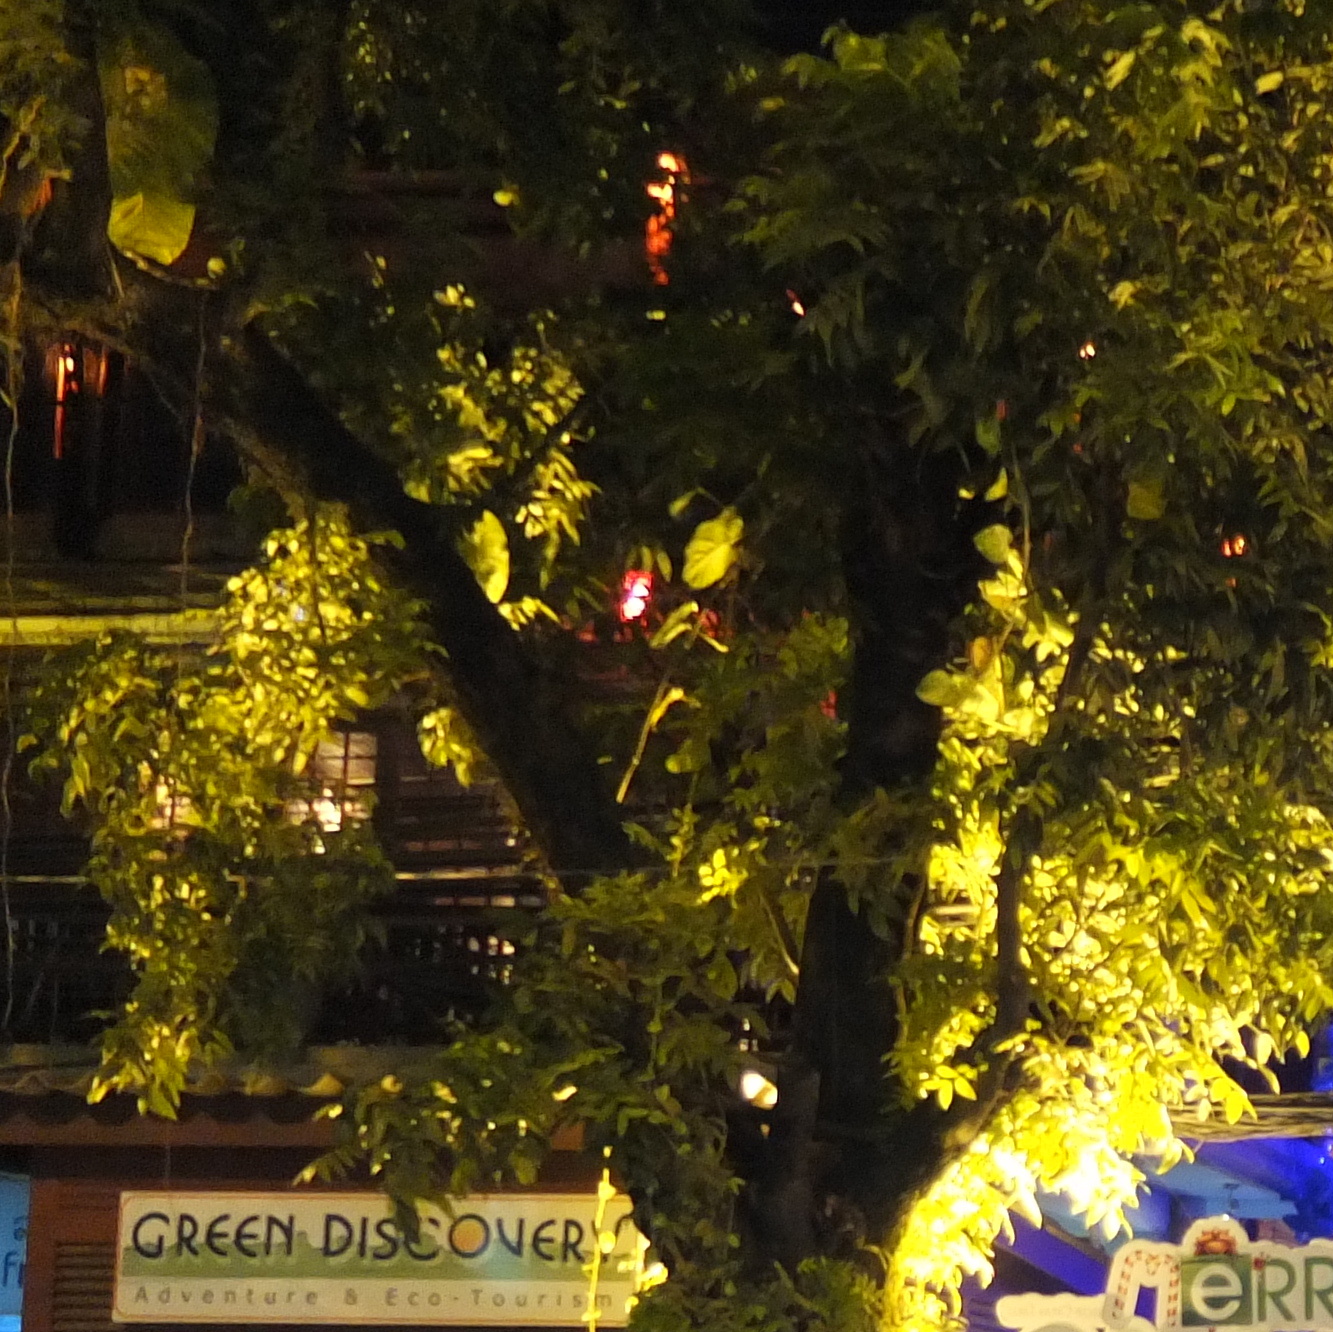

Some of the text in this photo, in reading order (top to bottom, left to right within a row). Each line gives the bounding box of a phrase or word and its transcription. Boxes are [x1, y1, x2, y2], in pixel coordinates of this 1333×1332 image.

[131, 1212, 295, 1260] GREEN
[133, 1288, 613, 1308] Adventure & Eco-Tourism
